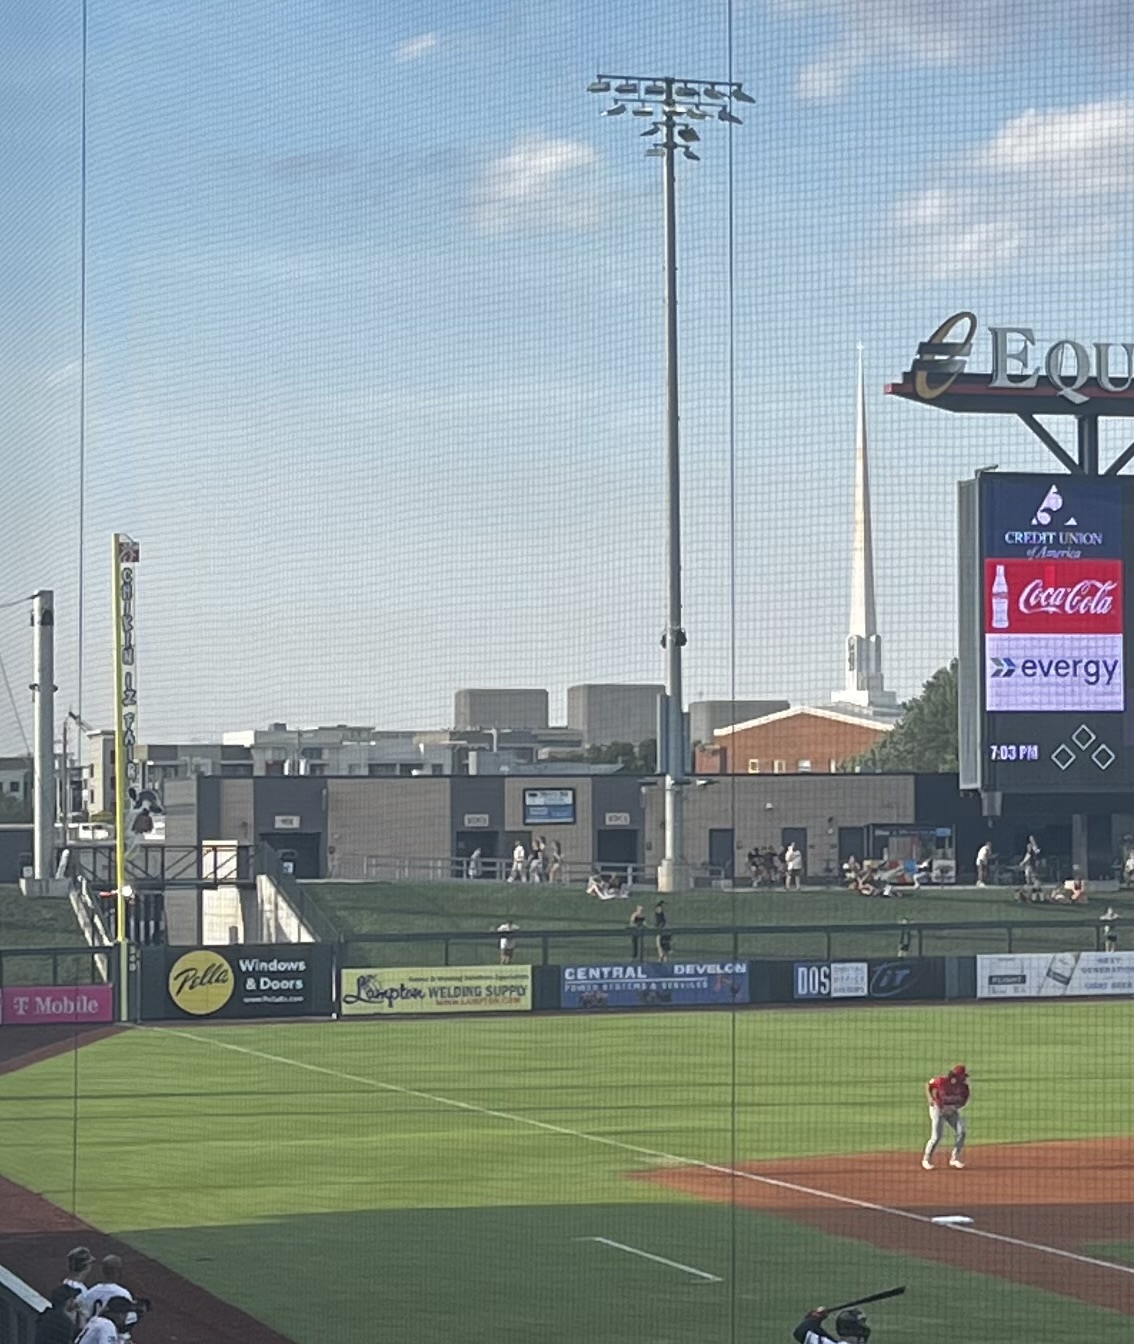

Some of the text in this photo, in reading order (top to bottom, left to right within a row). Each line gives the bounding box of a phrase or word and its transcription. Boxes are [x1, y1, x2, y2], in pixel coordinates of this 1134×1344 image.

[1005, 531, 1103, 545] CREDIT UNION
[1018, 579, 1118, 615] Coca-Cola
[1021, 659, 1119, 686] evergy
[990, 744, 1039, 761] 7:03 PM
[238, 958, 306, 972] Windows
[673, 963, 747, 975] DEVELON
[173, 963, 229, 997] Pella
[564, 966, 647, 980] CENTRAL
[797, 965, 830, 995] DOS
[245, 976, 303, 990] & Doors
[428, 985, 482, 998] WELDING
[485, 984, 527, 997] SUPPLY
